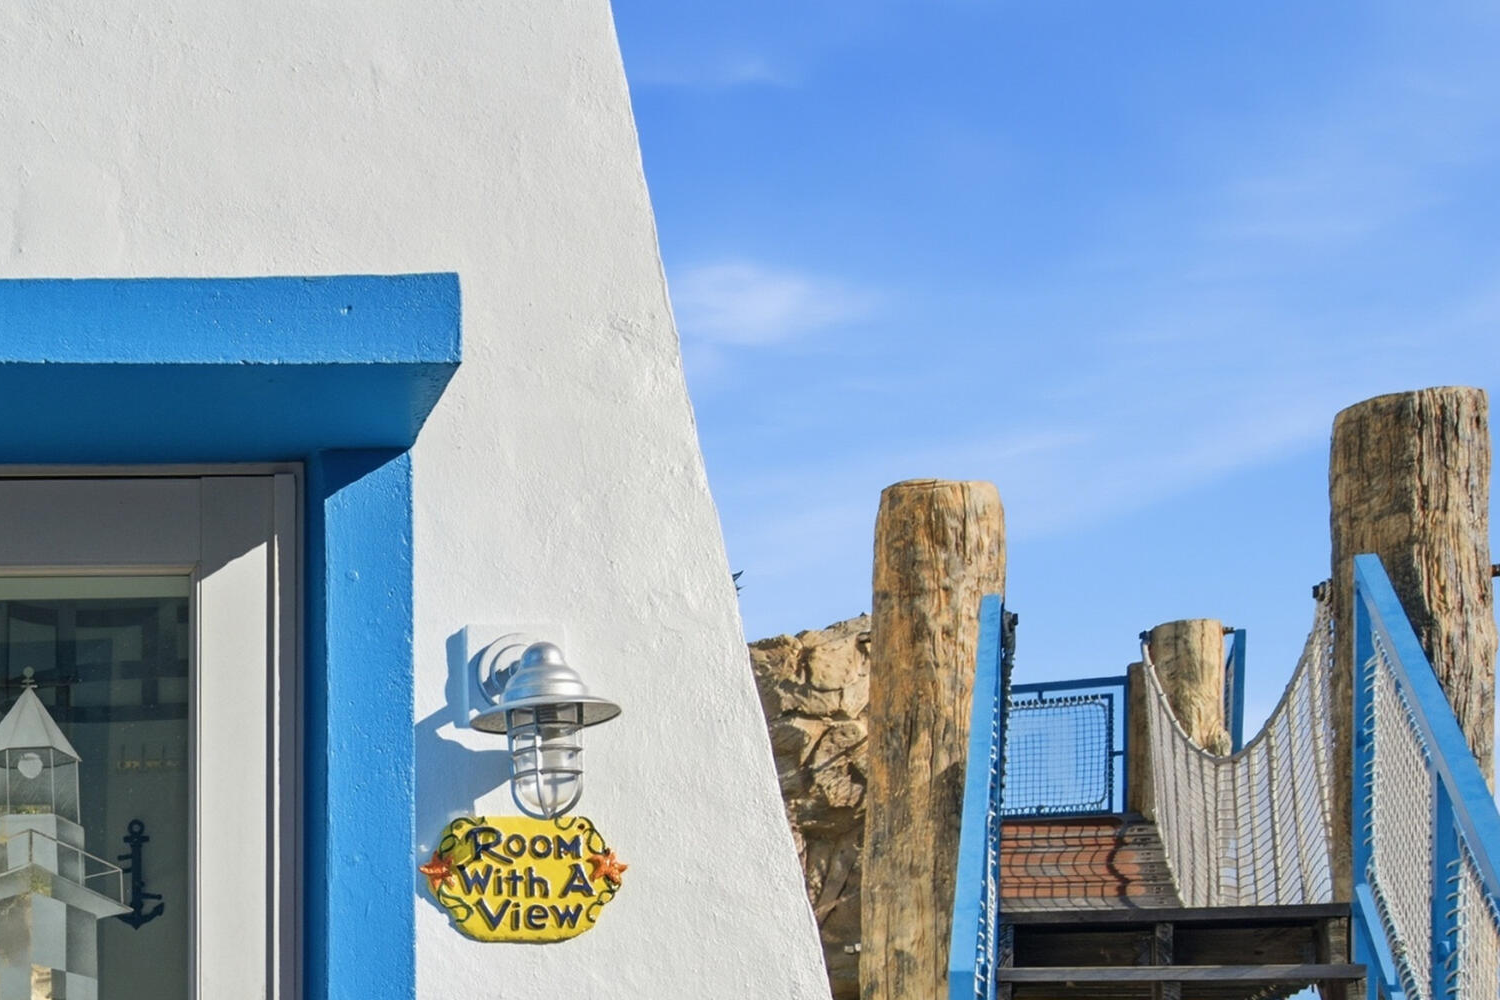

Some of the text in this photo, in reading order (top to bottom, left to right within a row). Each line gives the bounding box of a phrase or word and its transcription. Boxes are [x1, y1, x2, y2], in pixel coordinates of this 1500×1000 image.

[457, 863, 596, 898] With A
[474, 898, 583, 931] View
